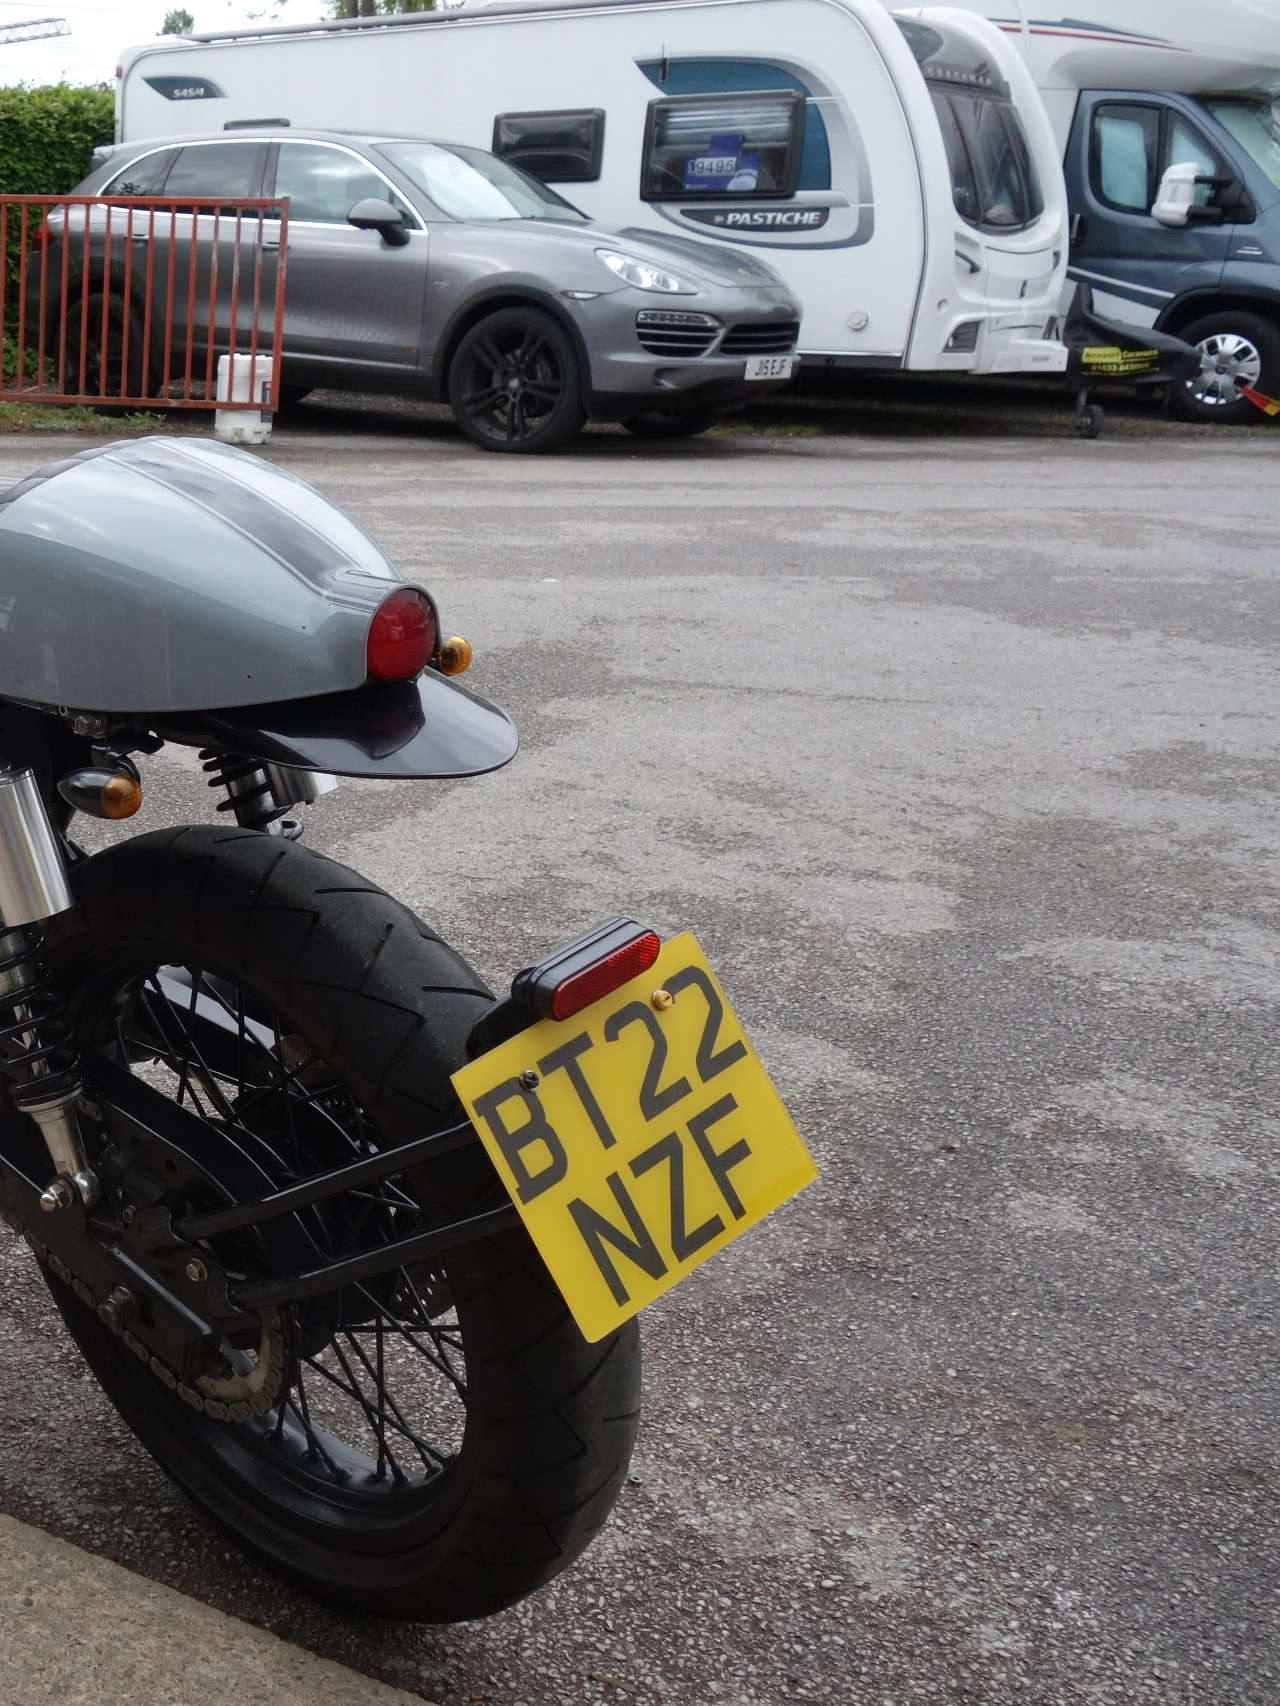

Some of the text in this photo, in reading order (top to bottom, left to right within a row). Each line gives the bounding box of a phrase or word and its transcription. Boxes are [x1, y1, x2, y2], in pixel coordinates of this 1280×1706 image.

[726, 211, 821, 225] PASTICHE
[472, 965, 748, 1206] BT22
[566, 1092, 752, 1308] NZF
